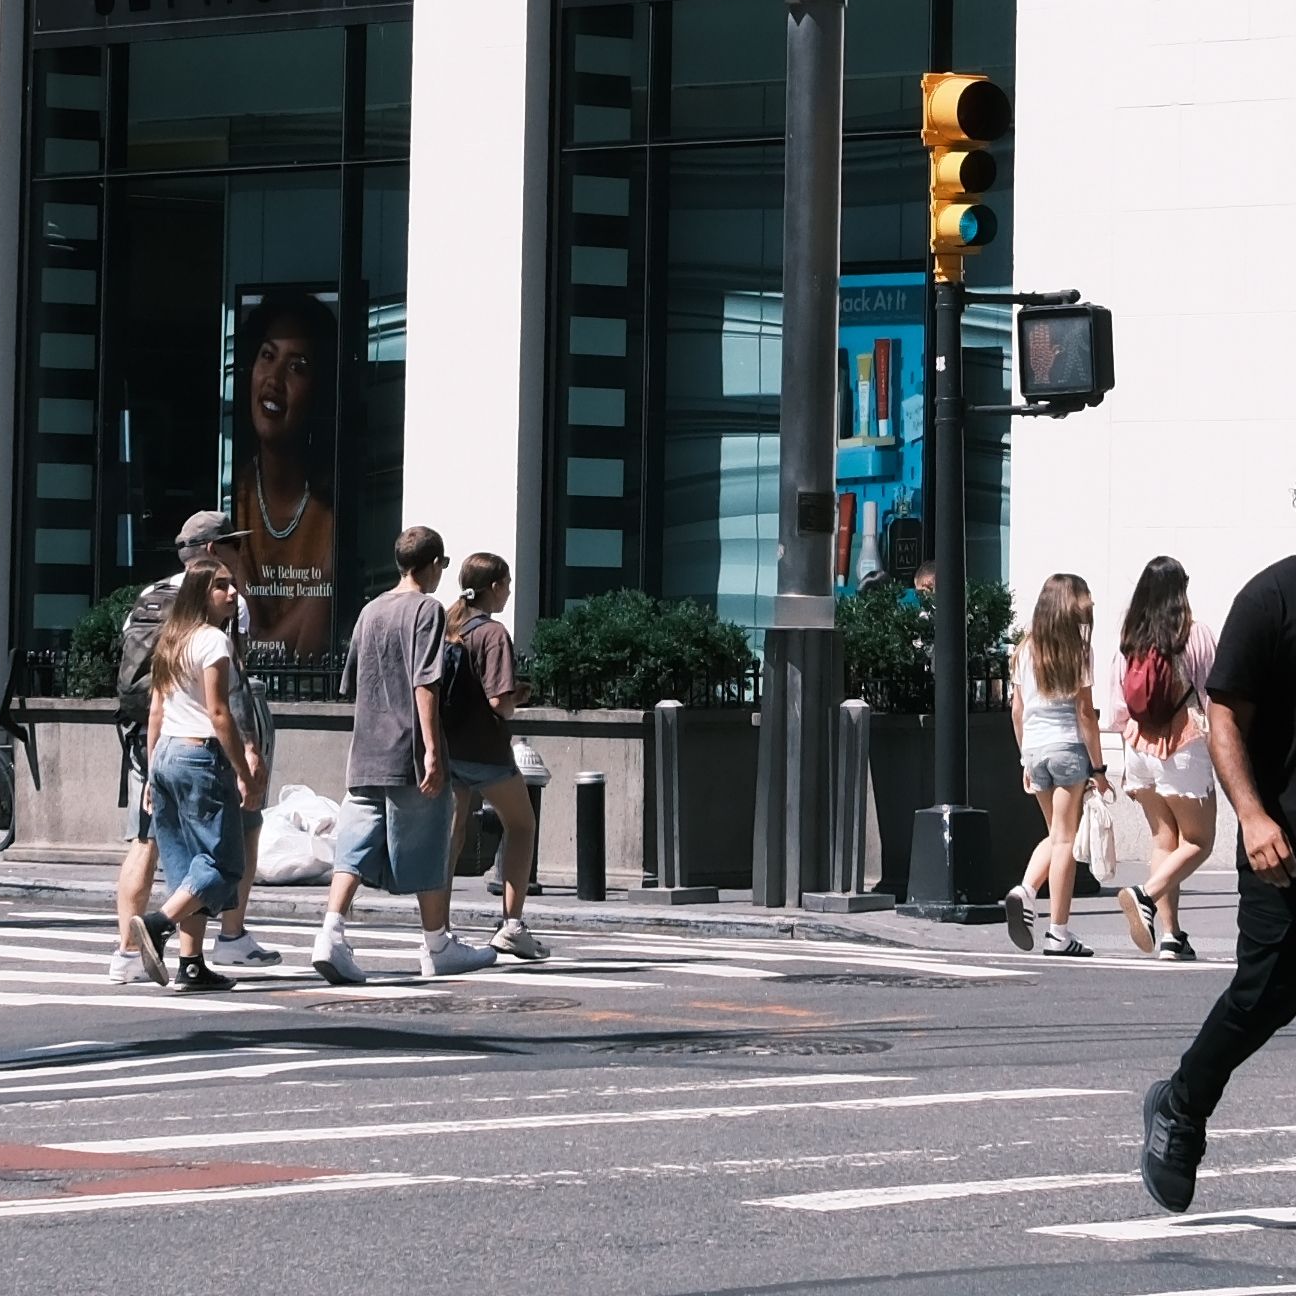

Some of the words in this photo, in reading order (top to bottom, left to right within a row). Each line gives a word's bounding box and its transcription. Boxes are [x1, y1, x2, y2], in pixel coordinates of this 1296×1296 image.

[873, 289, 892, 311] At
[262, 564, 276, 579] We
[278, 564, 309, 581] Belong
[311, 566, 322, 579] to
[245, 582, 294, 599] Something
